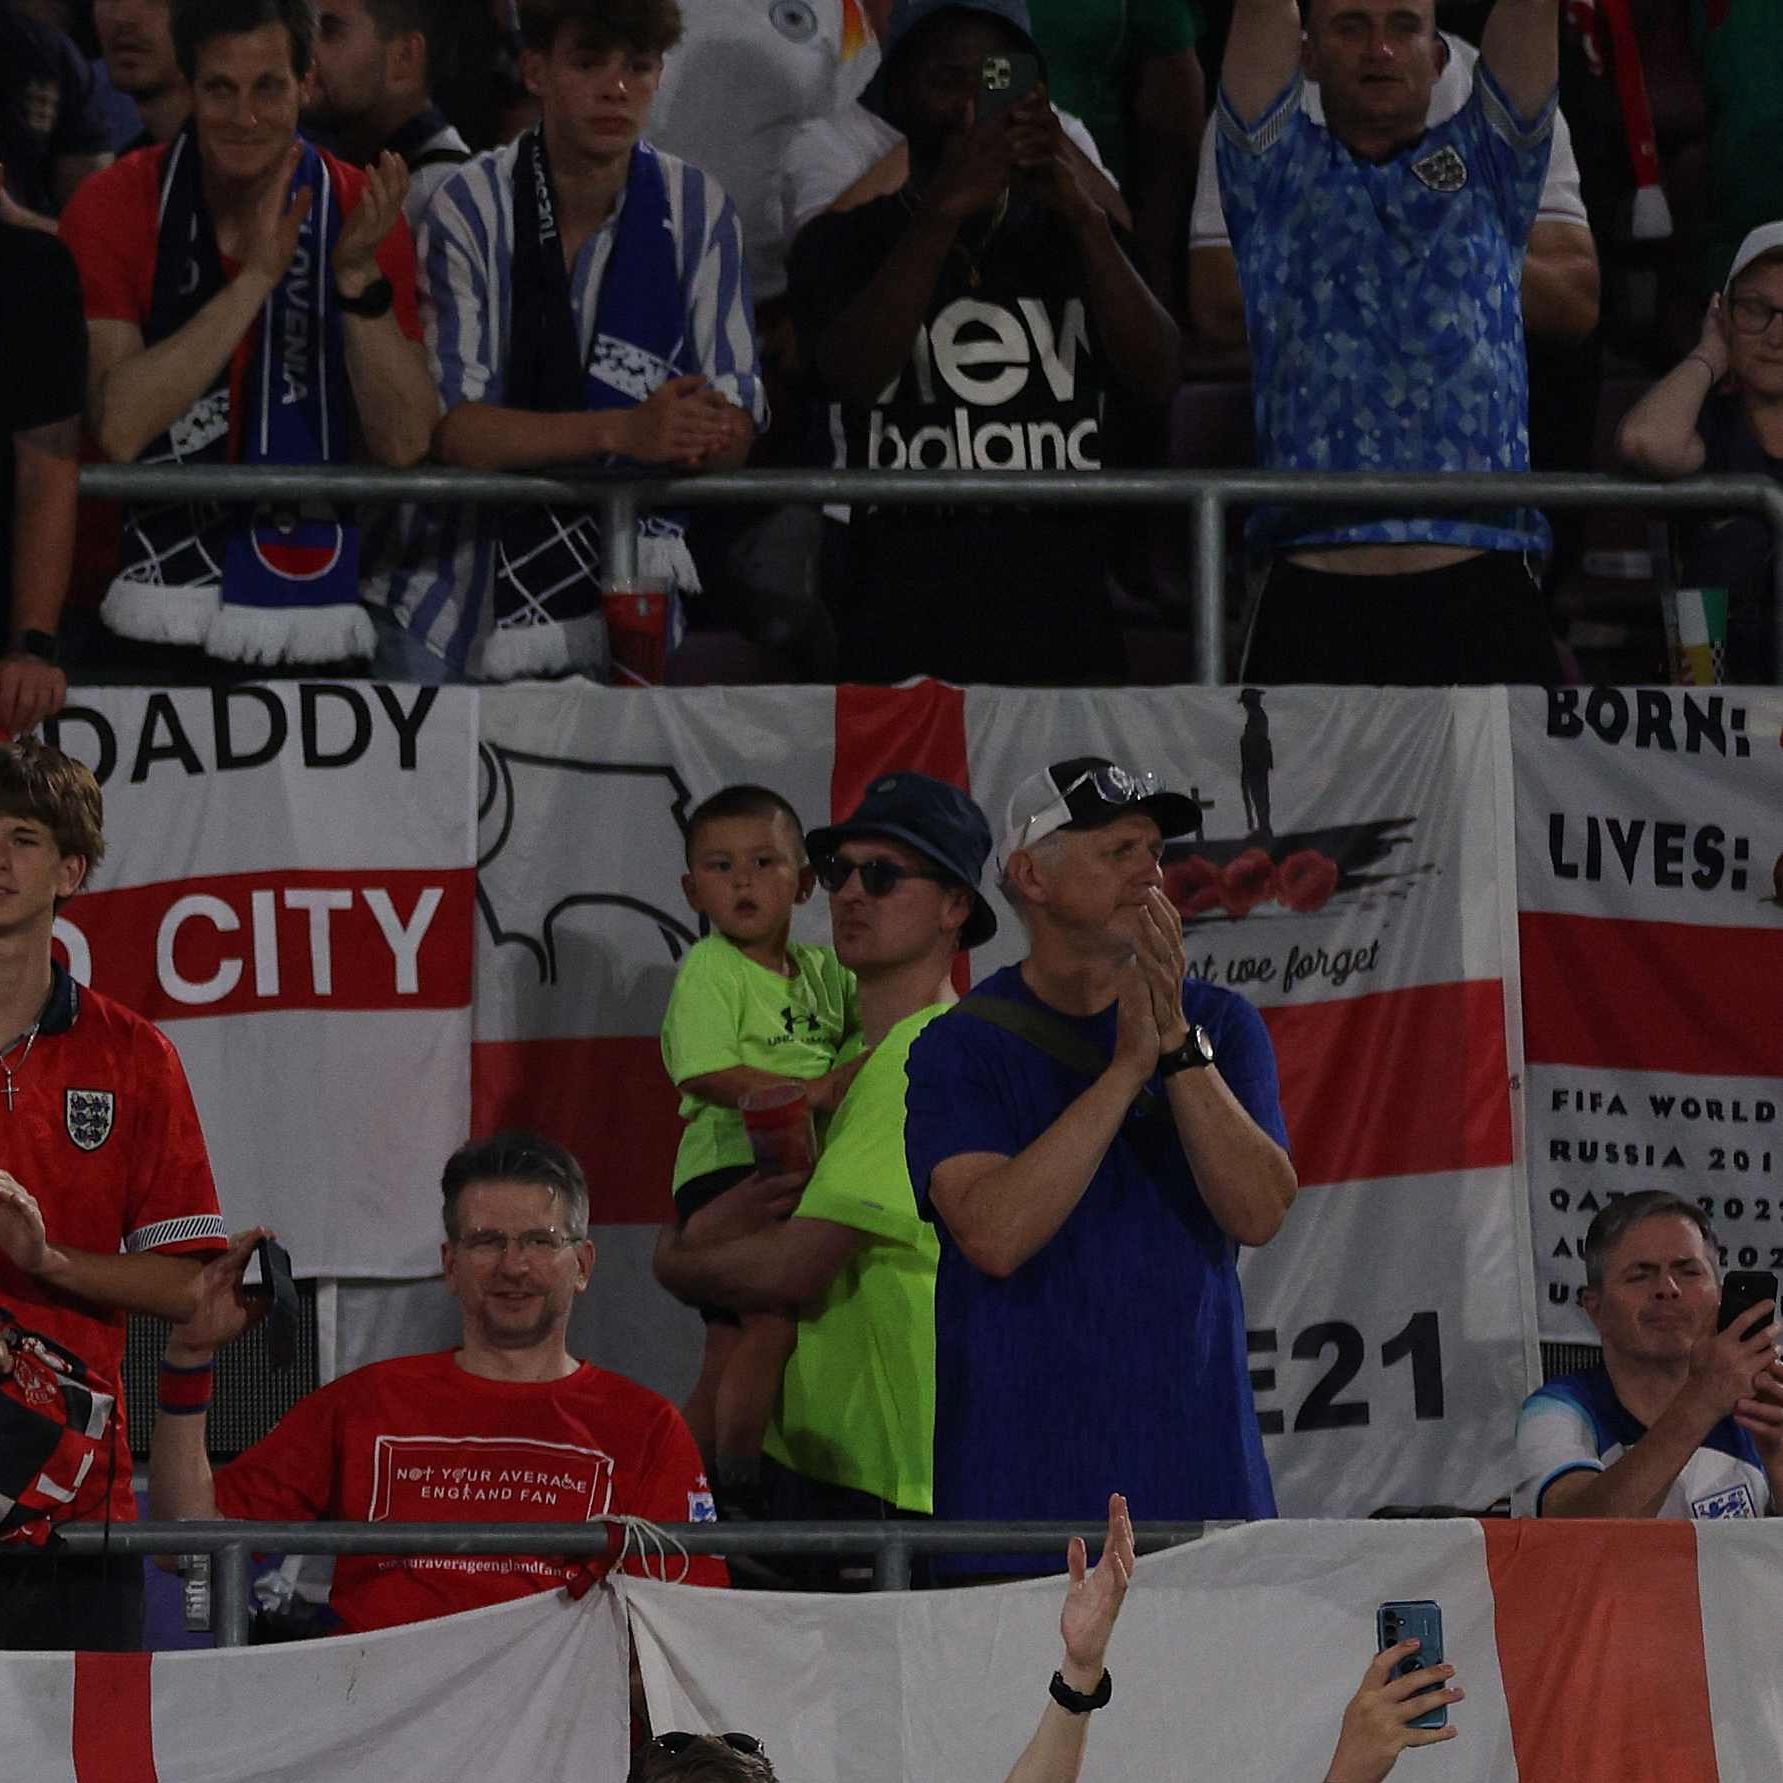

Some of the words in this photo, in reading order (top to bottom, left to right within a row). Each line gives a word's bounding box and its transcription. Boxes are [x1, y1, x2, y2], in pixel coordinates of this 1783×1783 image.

[279, 222, 318, 406] OVENIA
[42, 683, 439, 785] DADDY
[1546, 686, 1751, 758] BORN:
[1549, 813, 1750, 891] LIVES:
[156, 885, 445, 1002] CITY
[1227, 954, 1278, 983] we
[1282, 940, 1381, 993] forget
[1551, 1088, 1628, 1116] FIFA
[1649, 1094, 1776, 1122] WORLD
[1549, 1139, 1684, 1168] RUSSIA
[442, 1466, 492, 1483] YOUR
[520, 1489, 559, 1506] FAN
